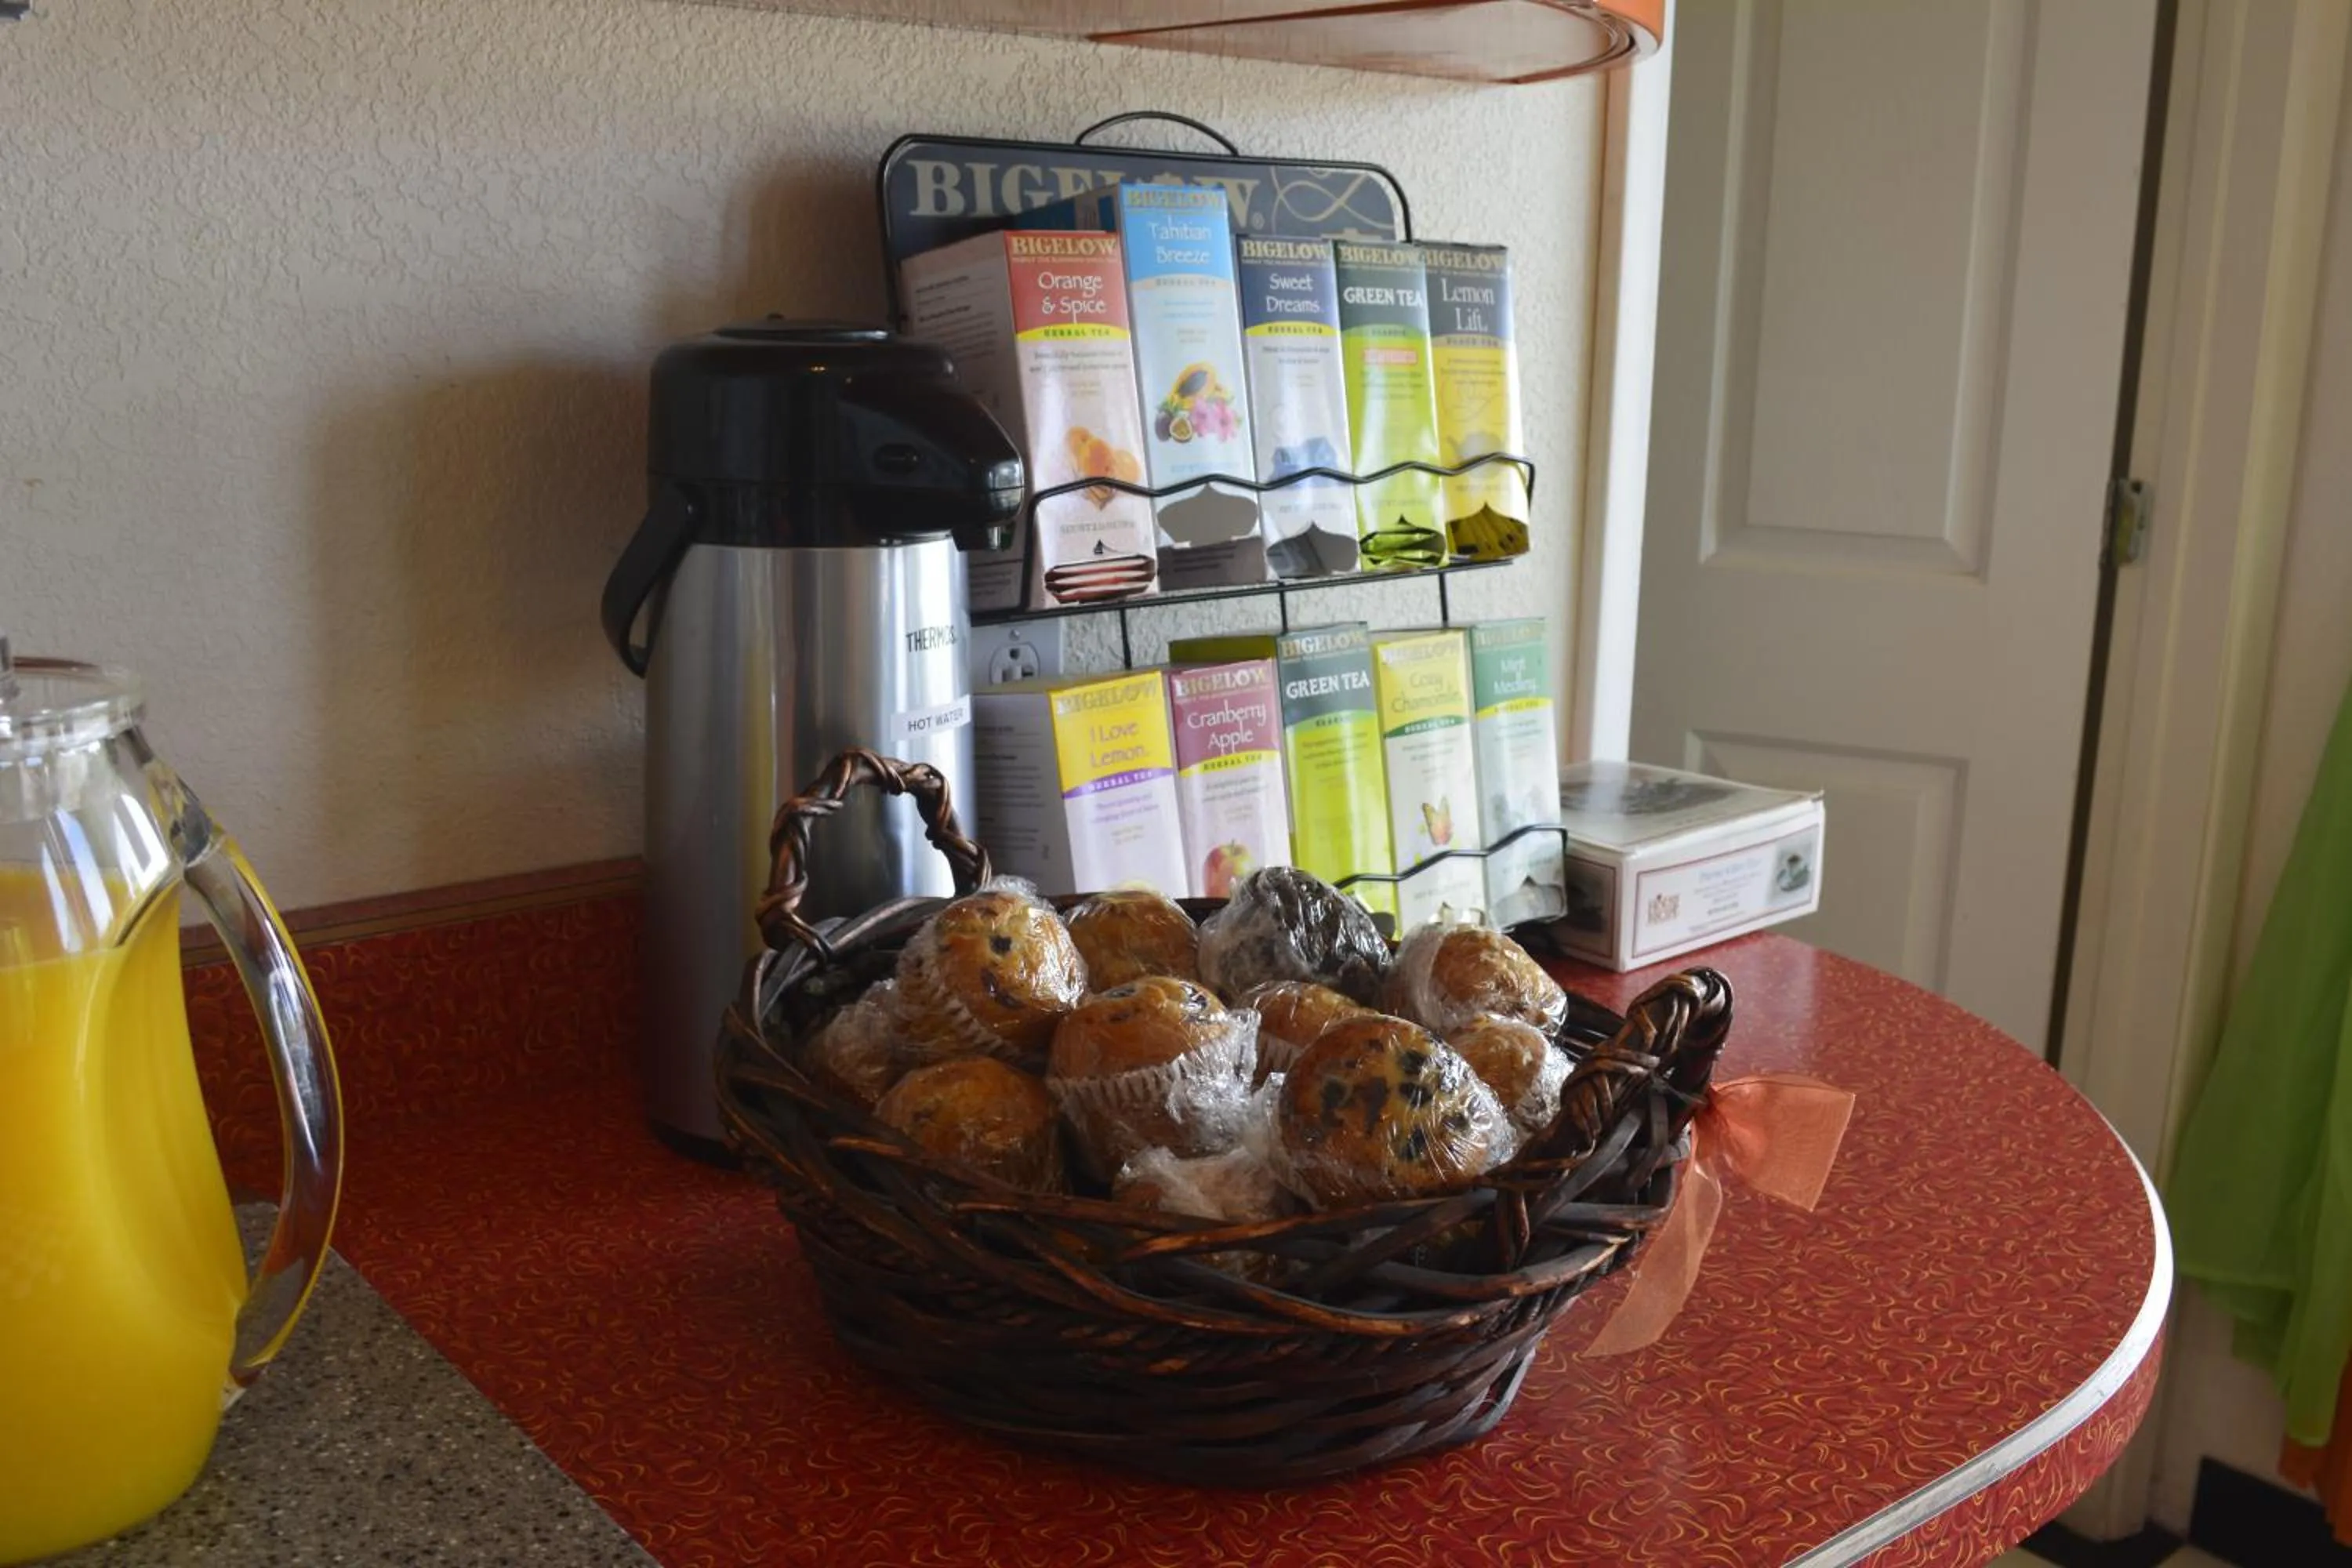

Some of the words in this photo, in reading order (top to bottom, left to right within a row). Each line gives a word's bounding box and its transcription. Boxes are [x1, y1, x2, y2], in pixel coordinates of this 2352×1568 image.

[1149, 215, 1212, 240] Tahitian
[1011, 236, 1116, 256] BIGELOW
[1156, 245, 1210, 263] Breeze
[1241, 240, 1327, 260] BIGELOW
[1338, 245, 1425, 269] BIGELOW
[1038, 271, 1103, 298] Orange
[1269, 274, 1313, 292] Sweet
[1440, 278, 1495, 306] Lemon
[1342, 286, 1394, 306] GREEN
[1397, 289, 1424, 309] TEA
[1041, 296, 1055, 314] &
[1060, 297, 1107, 324] Spice
[1044, 328, 1085, 337] HERBAL
[1281, 630, 1366, 658] BIGELOW
[1174, 667, 1268, 698] BIGELOW
[1286, 675, 1339, 699] GREEN
[1341, 669, 1370, 691] TEA
[908, 717, 932, 731] HOT
[935, 708, 964, 726] WATER
[1187, 700, 1267, 729] Cranberry
[1100, 722, 1138, 742] Love
[1208, 729, 1254, 755] Apple
[1203, 757, 1242, 771] HERBAL
